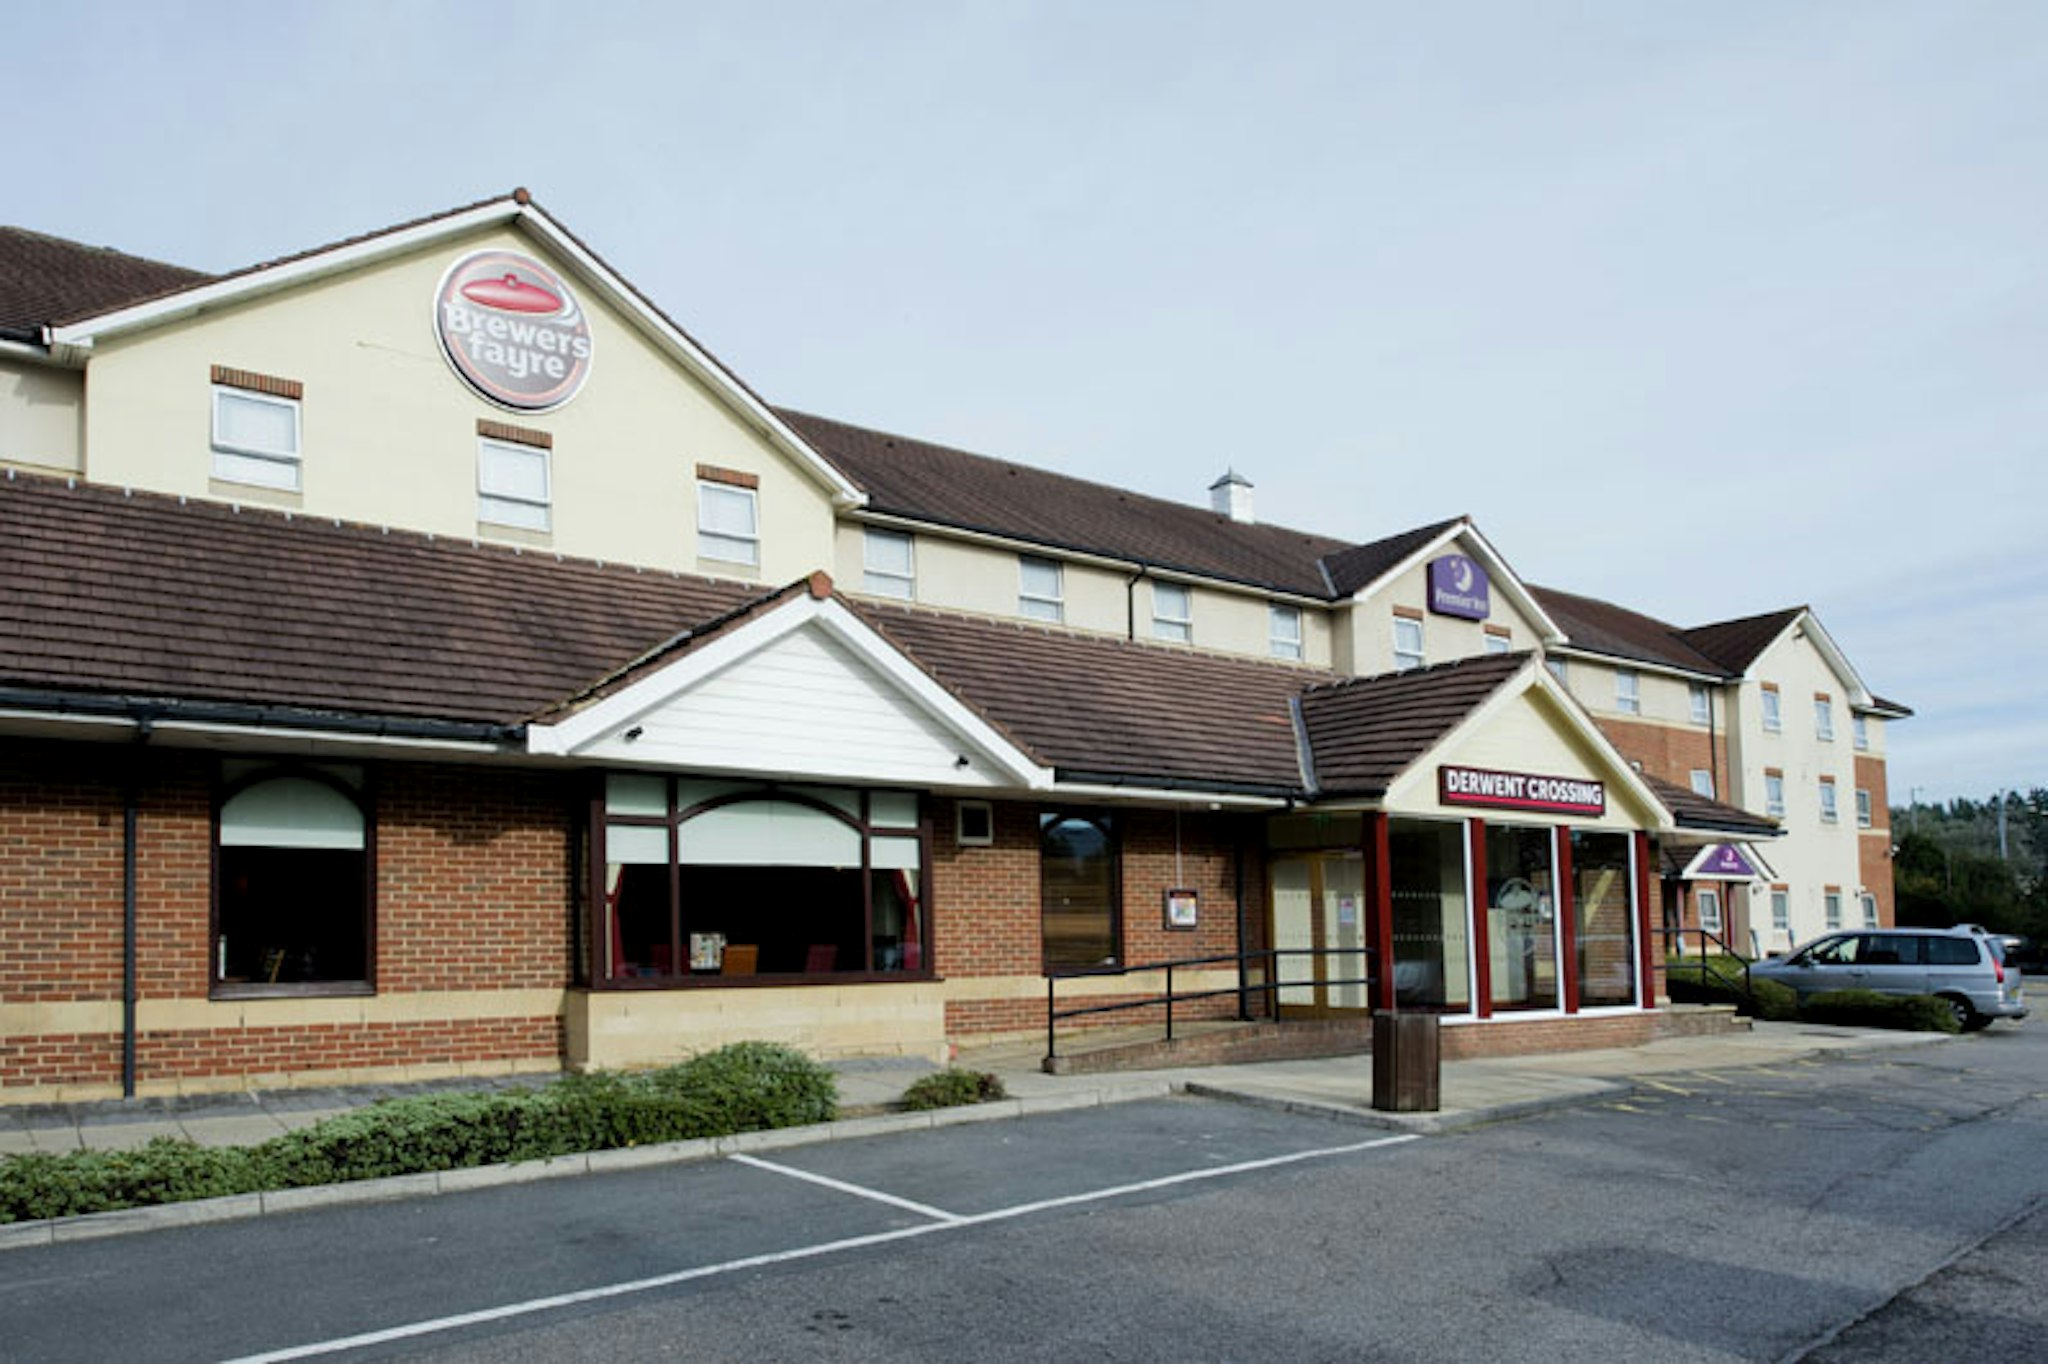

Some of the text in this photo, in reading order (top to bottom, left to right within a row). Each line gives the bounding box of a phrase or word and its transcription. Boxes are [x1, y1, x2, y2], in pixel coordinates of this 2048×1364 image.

[443, 302, 590, 358] Brewers
[1447, 770, 1602, 805] DERWENT CROSSING
